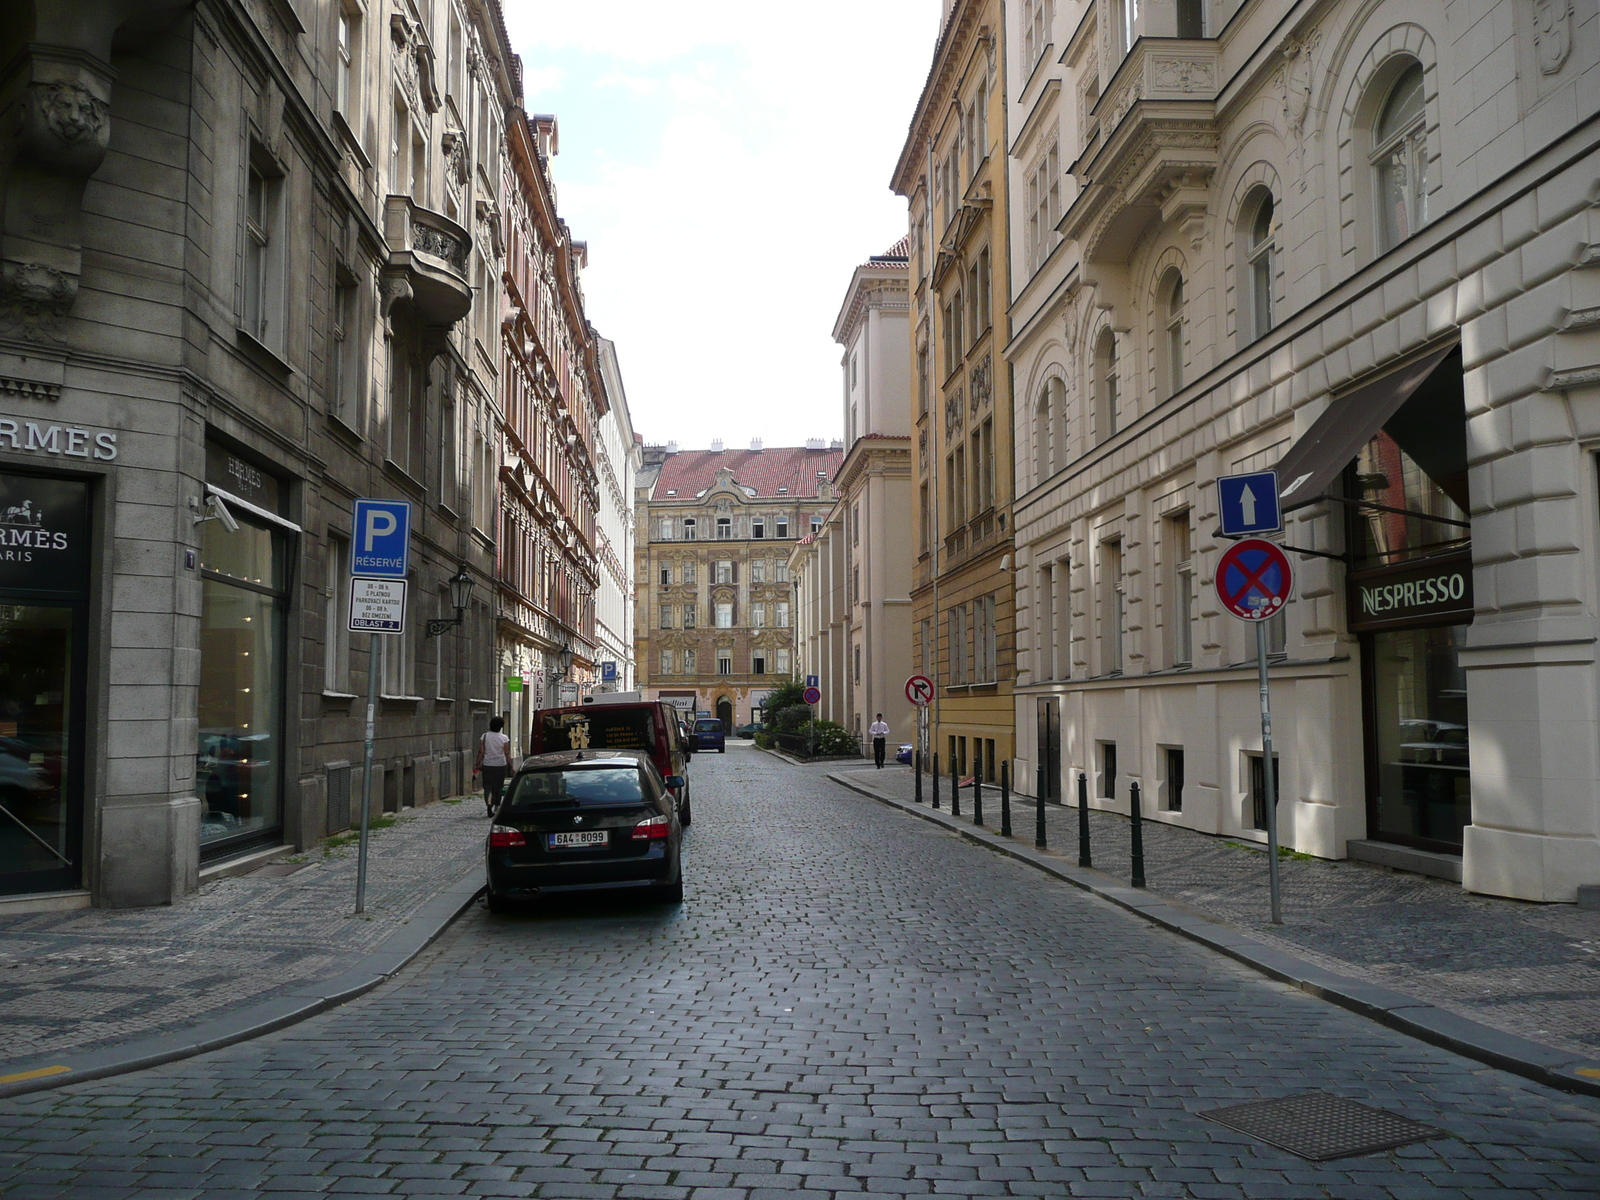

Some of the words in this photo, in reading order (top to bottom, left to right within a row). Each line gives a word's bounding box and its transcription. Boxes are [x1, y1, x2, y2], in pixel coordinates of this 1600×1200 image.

[364, 509, 397, 552] P
[355, 555, 403, 568] RÉSERVÉ
[1360, 573, 1464, 616] NESPRESSO
[354, 619, 384, 627] OBLAST
[388, 621, 394, 629] 2
[604, 663, 613, 676] P
[670, 699, 688, 707] llini
[557, 833, 574, 844] 6A4
[580, 832, 604, 843] 8099
